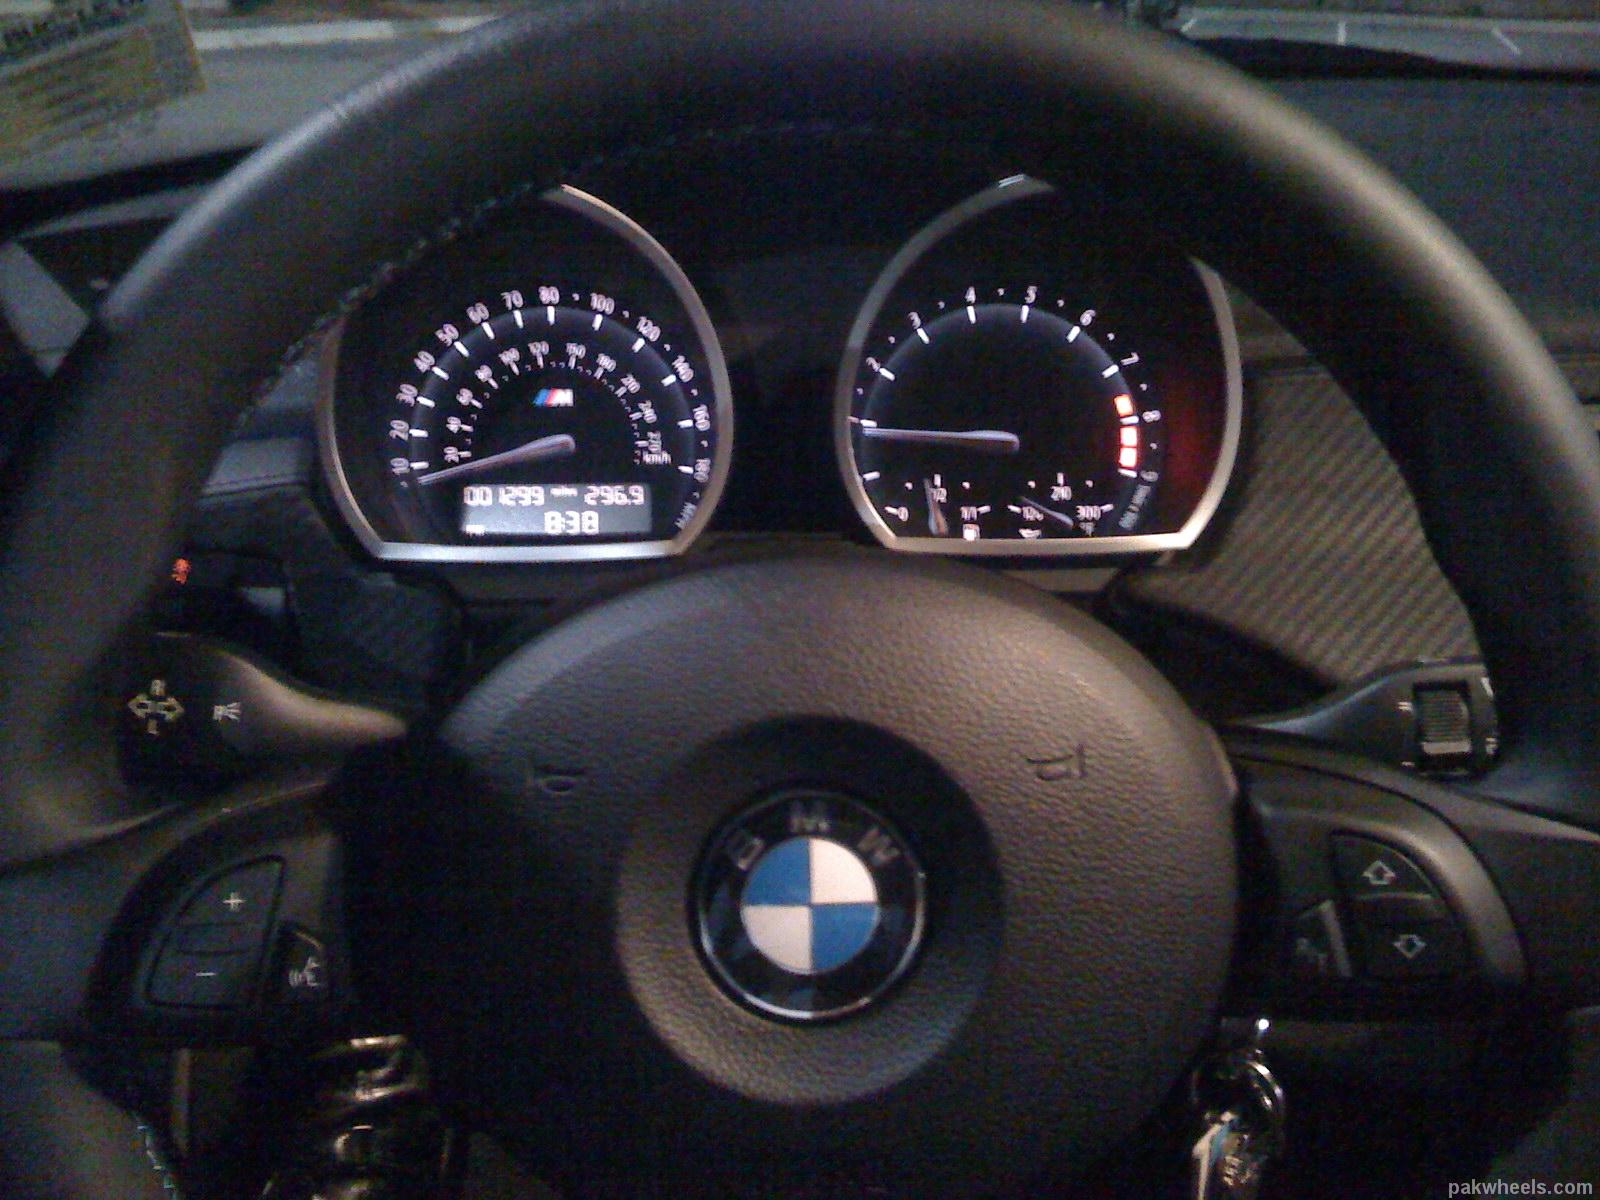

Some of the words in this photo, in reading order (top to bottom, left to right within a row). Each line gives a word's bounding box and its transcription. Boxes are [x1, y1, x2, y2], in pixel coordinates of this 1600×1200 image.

[501, 290, 524, 310] 70
[539, 286, 560, 304] 80
[590, 292, 615, 315] 100
[965, 286, 976, 304] 4
[1024, 286, 1038, 304] 5
[466, 302, 490, 324] 60
[908, 311, 921, 329] 3
[1080, 309, 1096, 326] 6
[435, 323, 459, 346] 50
[636, 316, 661, 342] 120
[414, 351, 435, 373] 40
[672, 355, 694, 382] 140
[866, 357, 881, 373] 2
[1120, 352, 1139, 366] 7
[396, 384, 418, 407] 30
[1142, 410, 1161, 423] 8
[389, 419, 409, 441] 20
[390, 458, 410, 475] 10
[584, 485, 644, 506] 296.9
